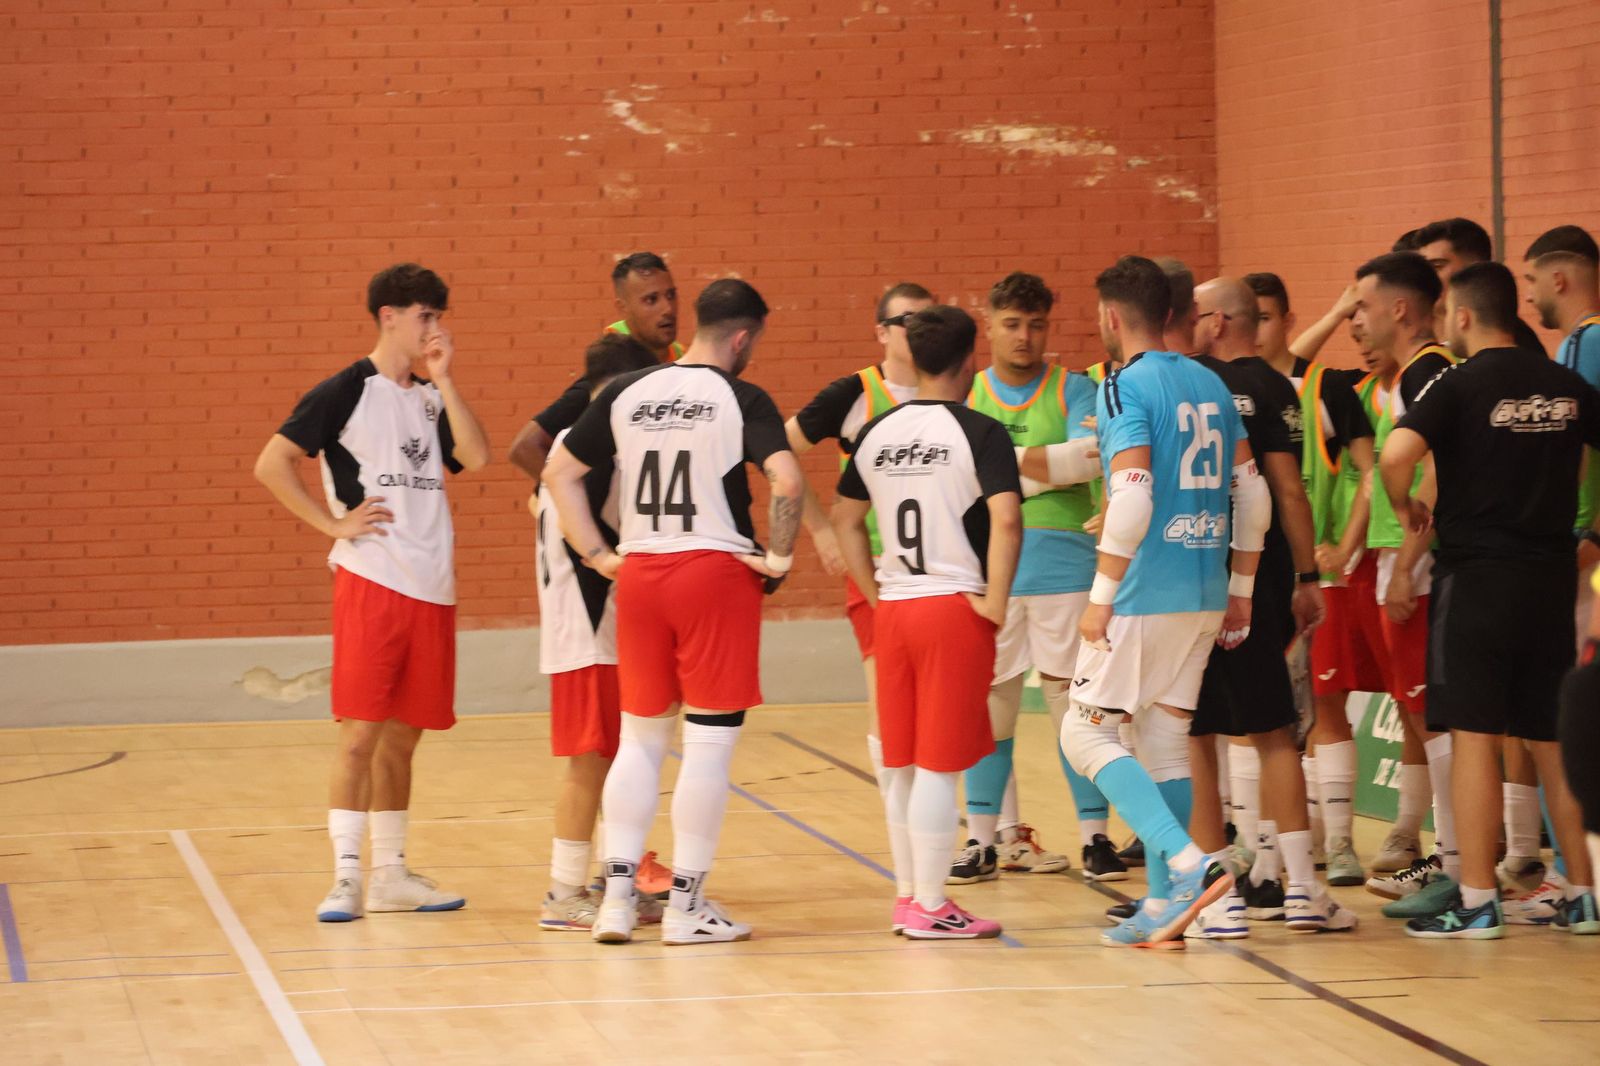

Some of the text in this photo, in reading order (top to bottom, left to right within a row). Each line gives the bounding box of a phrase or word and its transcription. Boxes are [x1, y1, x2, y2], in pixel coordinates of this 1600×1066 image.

[1177, 402, 1223, 489] 25
[636, 450, 697, 532] 44
[897, 499, 927, 575] 9
